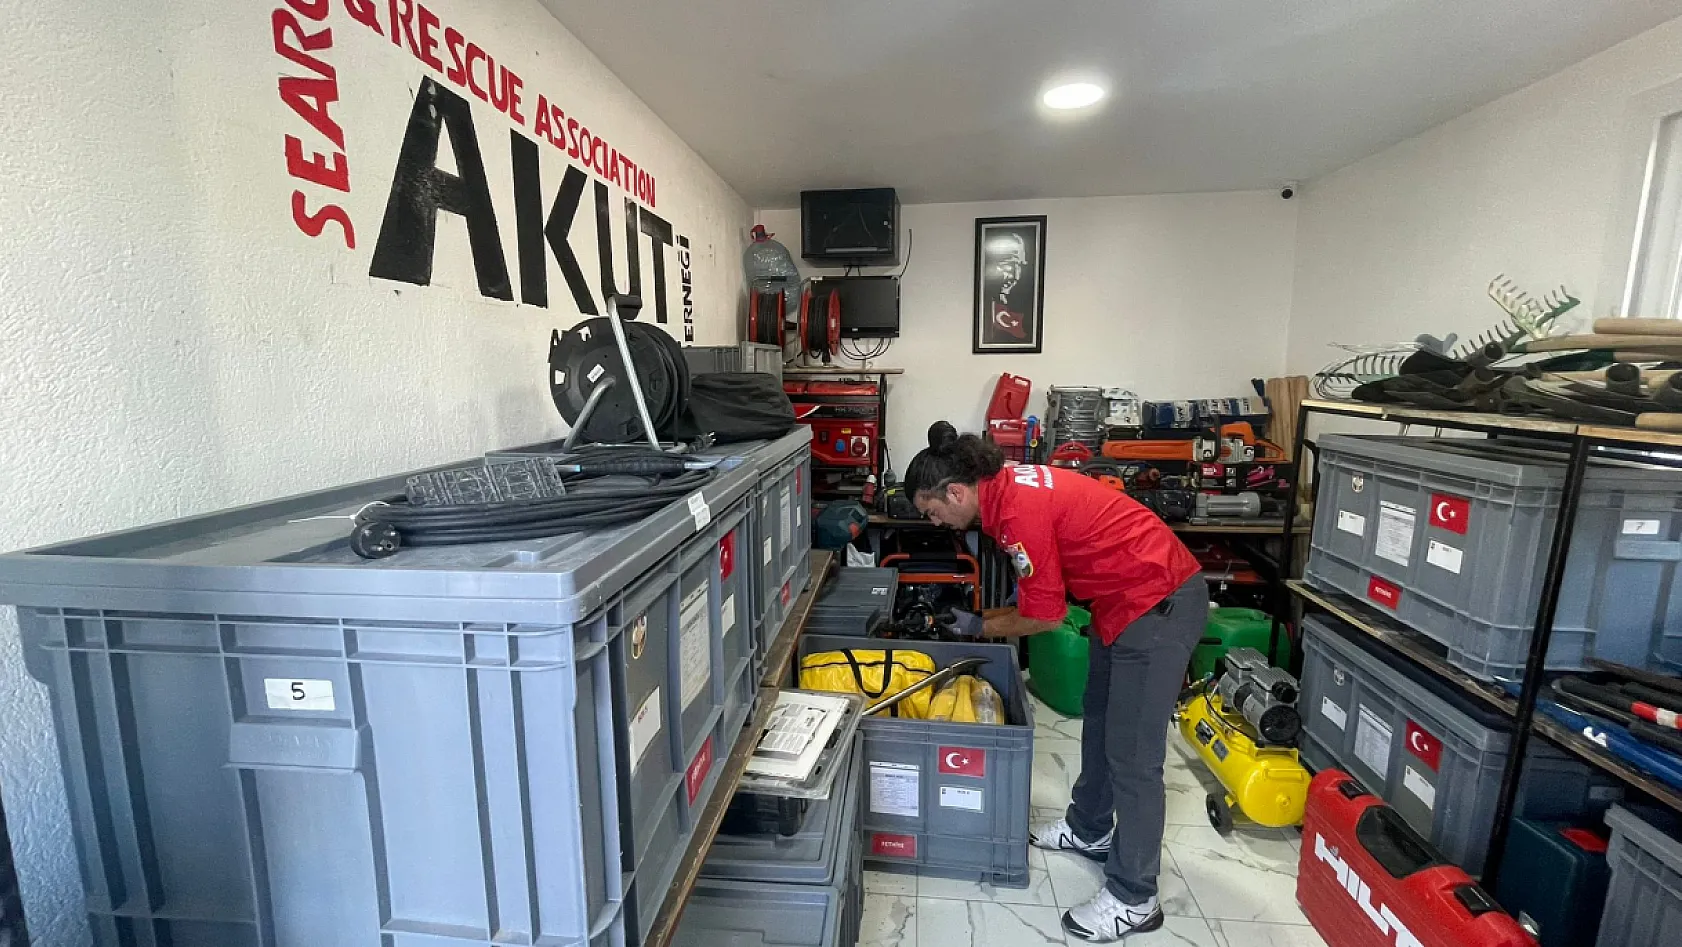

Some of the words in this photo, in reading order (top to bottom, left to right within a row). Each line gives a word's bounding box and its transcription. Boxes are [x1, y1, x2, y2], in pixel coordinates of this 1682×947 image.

[388, 0, 524, 125] RESCUE
[535, 94, 656, 207] ASSOCIATION
[369, 75, 673, 324] AKUT
[677, 234, 694, 342] ERNEĞİ
[291, 682, 306, 701] 5
